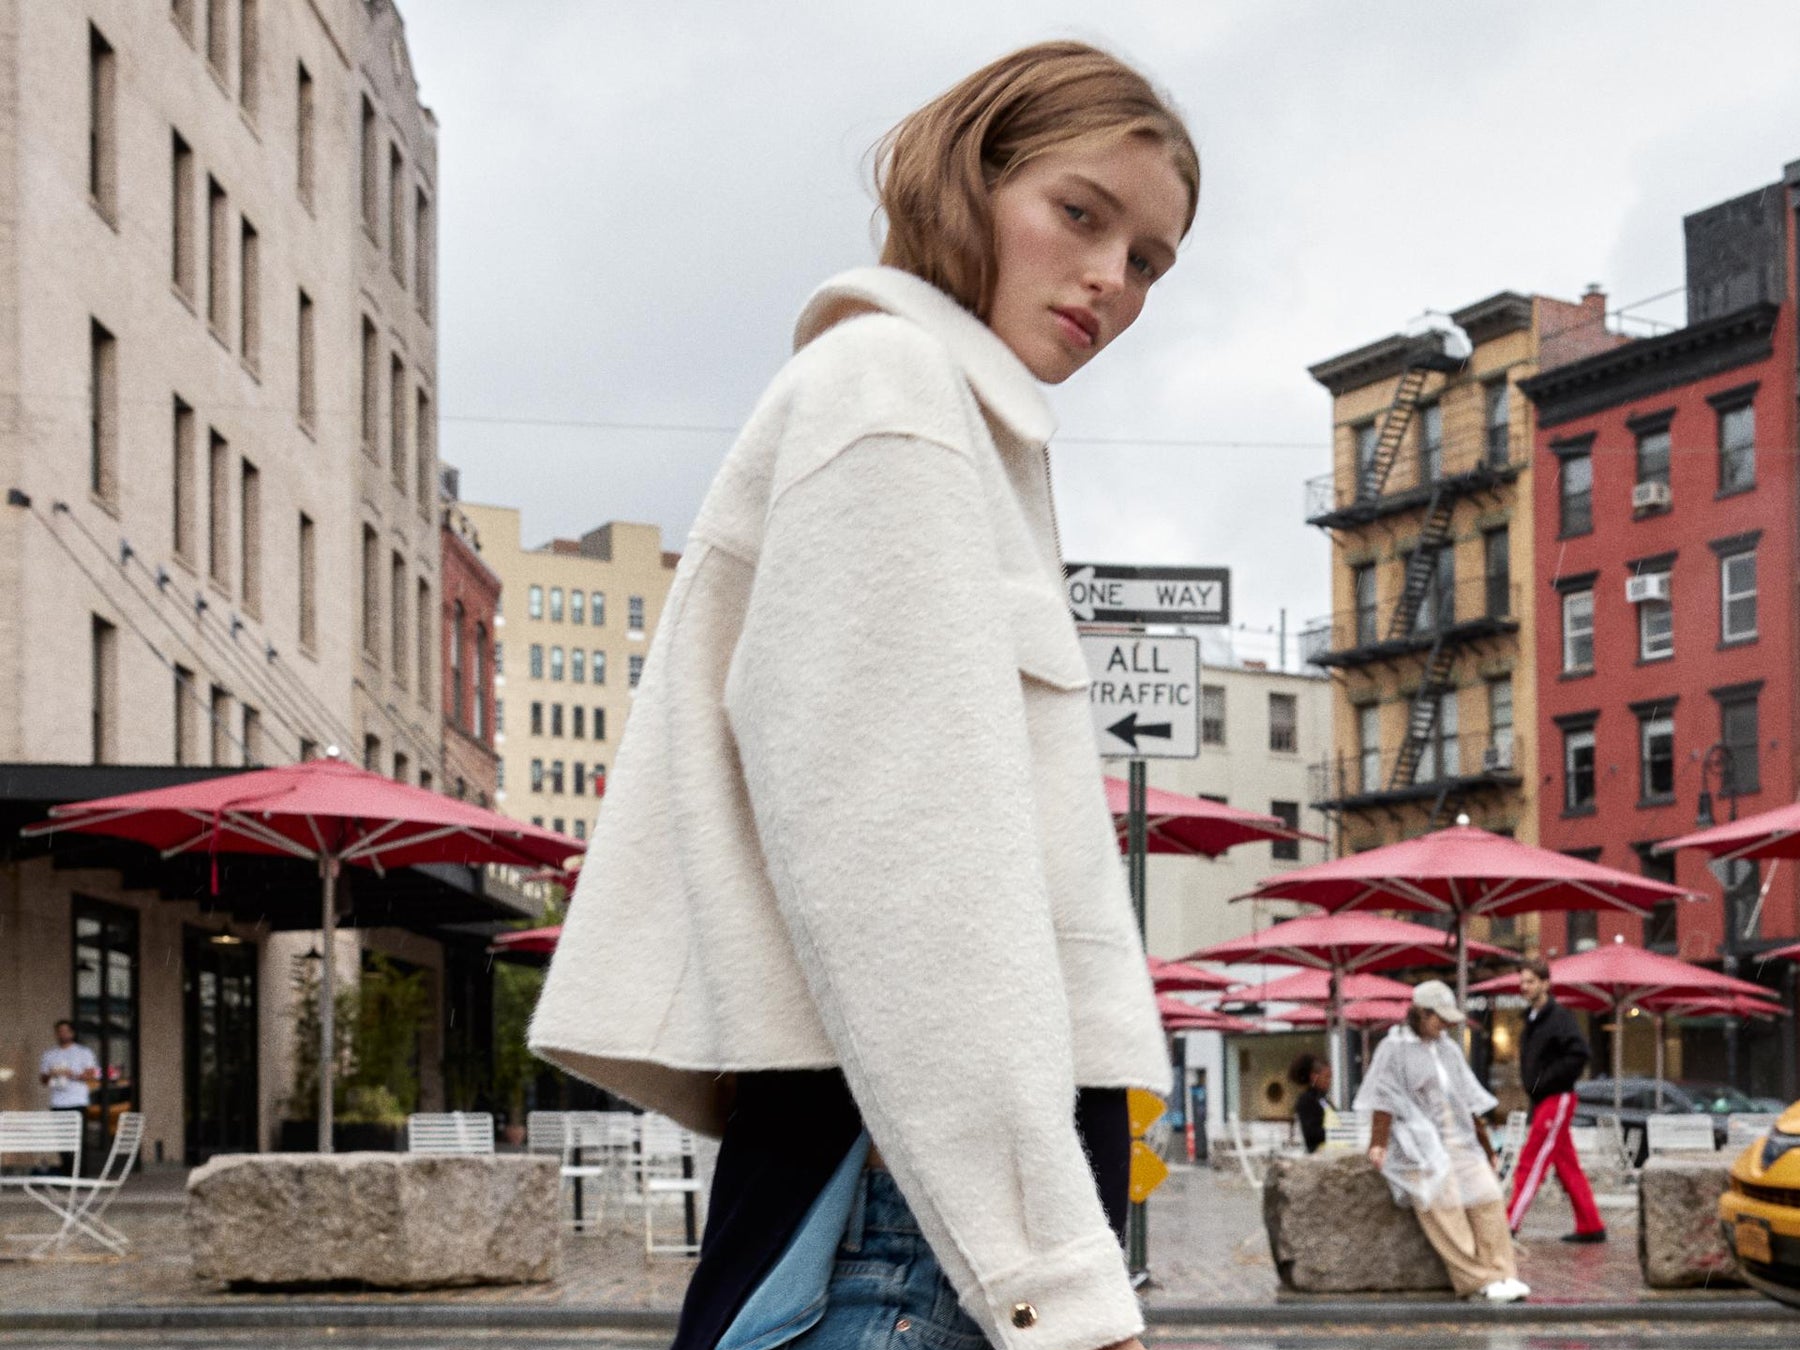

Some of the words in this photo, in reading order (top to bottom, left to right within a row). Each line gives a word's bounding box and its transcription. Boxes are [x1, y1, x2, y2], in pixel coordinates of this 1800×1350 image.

[1070, 583, 1122, 605] ONE
[1156, 585, 1212, 606] WAY
[1107, 644, 1169, 673] ALL
